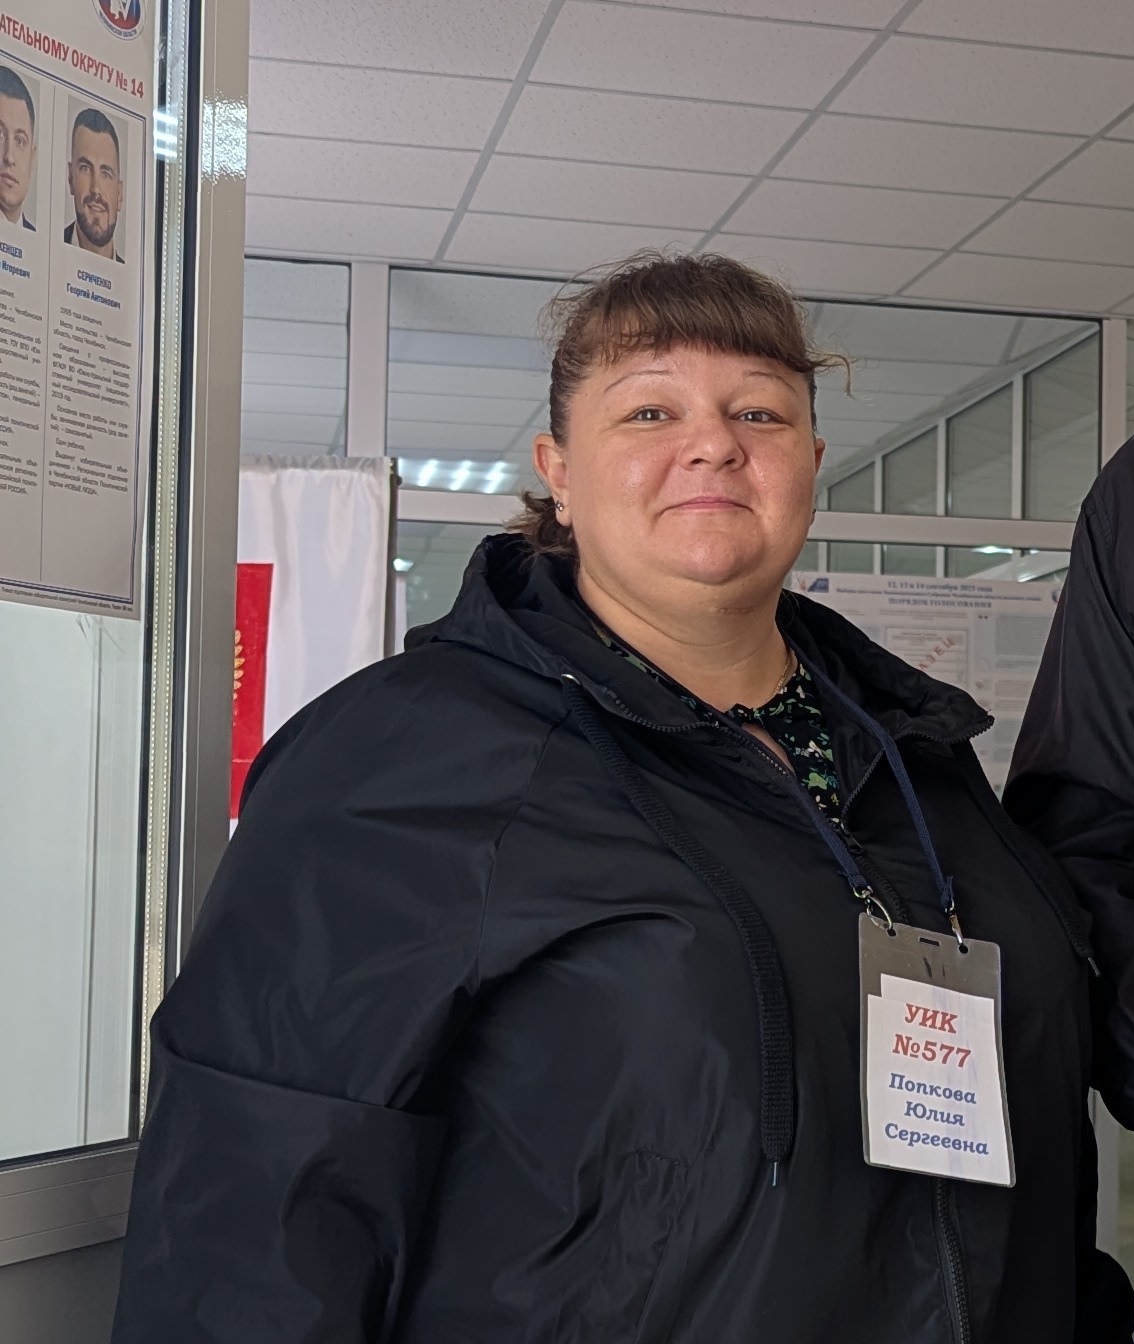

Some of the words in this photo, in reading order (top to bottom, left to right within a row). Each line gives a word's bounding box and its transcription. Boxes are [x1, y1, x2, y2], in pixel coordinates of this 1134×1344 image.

[72, 49, 114, 83] ОКРУГУ
[115, 70, 128, 91] №
[131, 77, 144, 99] 14
[904, 1003, 958, 1034] УИК
[892, 1034, 971, 1068] №577
[888, 1072, 977, 1105] Попкова
[904, 1101, 965, 1127] Юлия
[884, 1123, 989, 1156] Сергеевна
